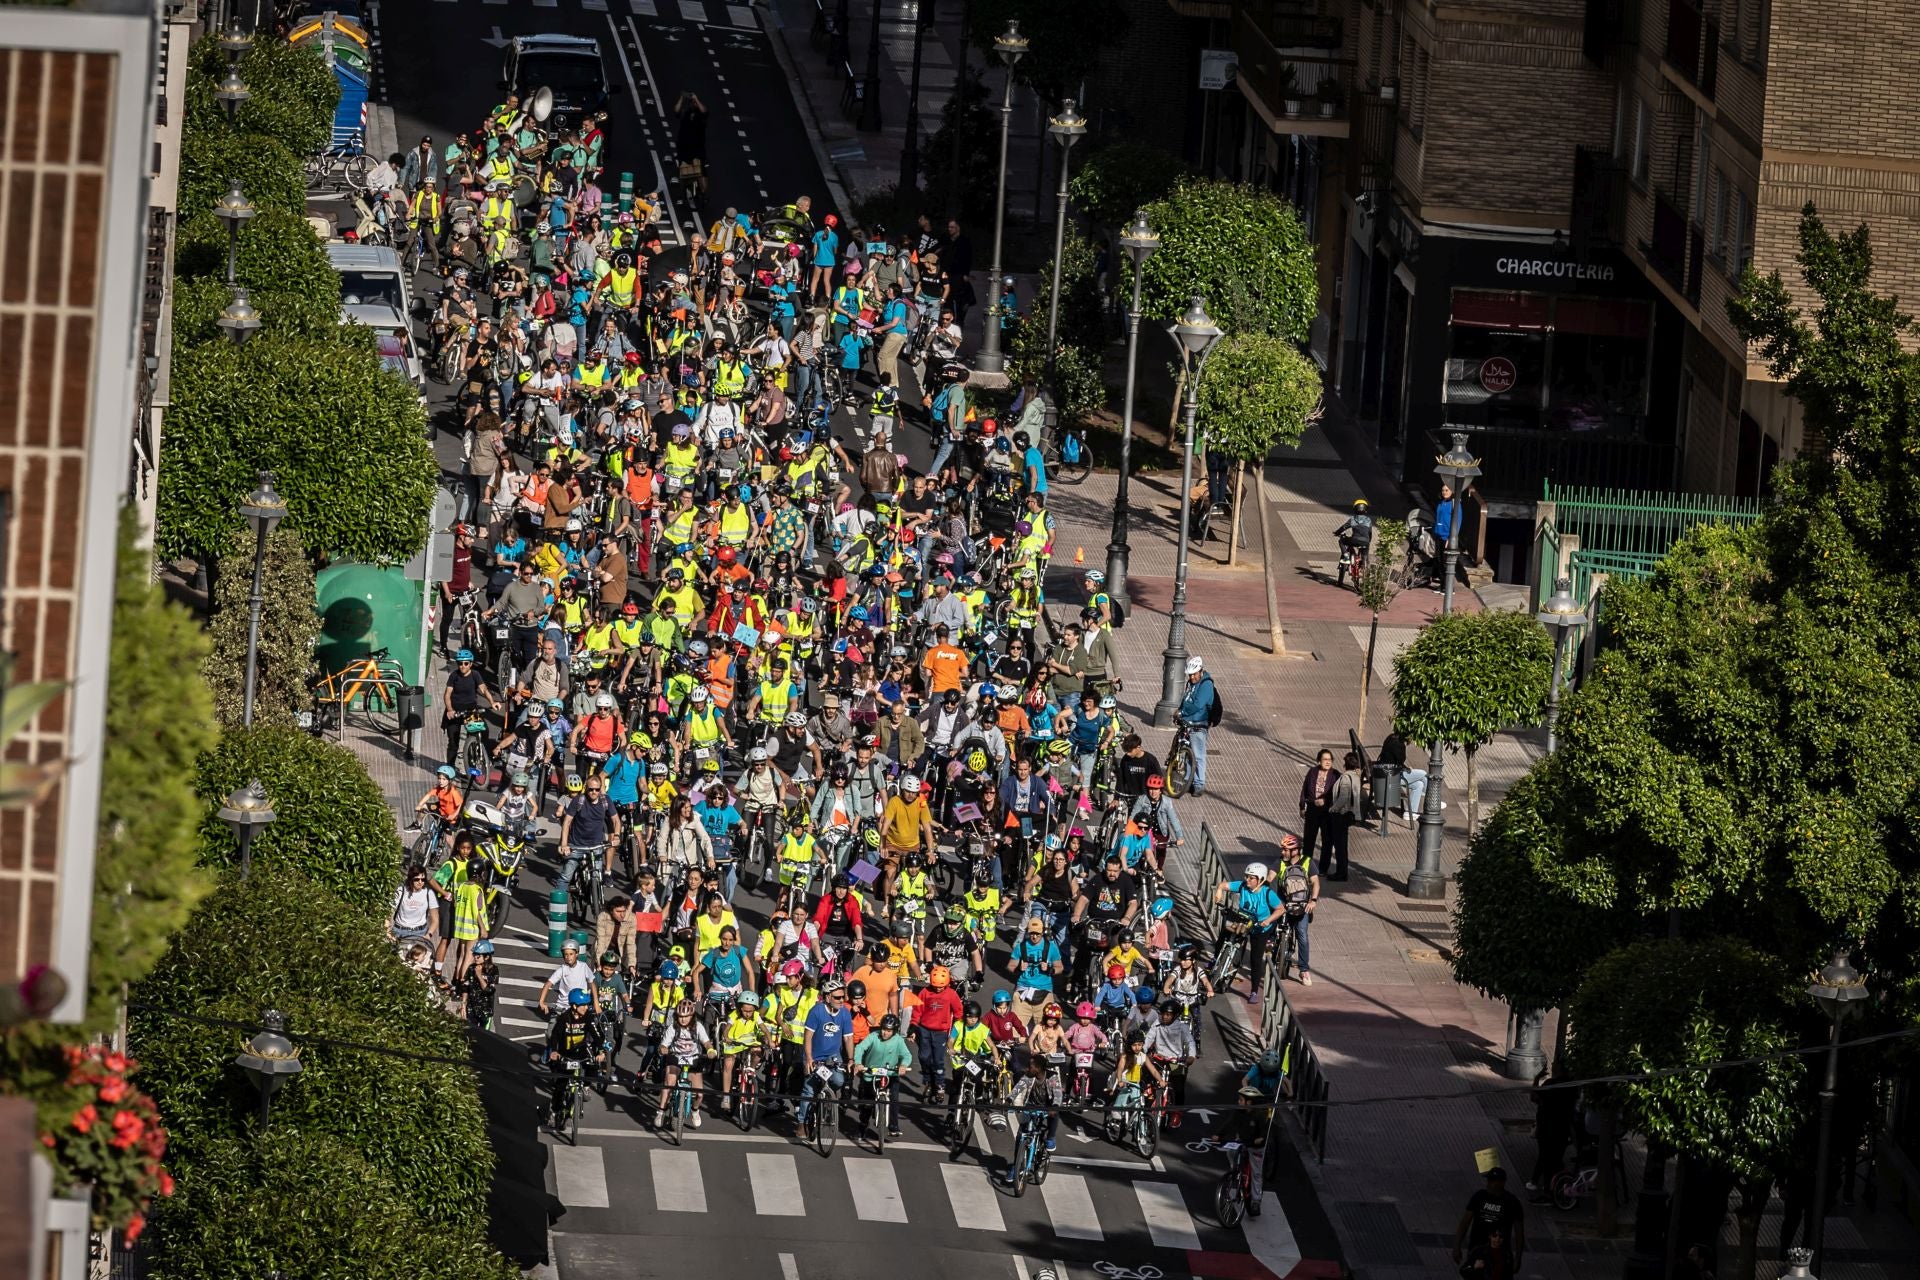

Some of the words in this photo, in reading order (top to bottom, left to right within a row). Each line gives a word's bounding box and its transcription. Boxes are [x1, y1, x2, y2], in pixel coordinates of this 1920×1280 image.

[1496, 257, 1615, 281] CHARCUTERIA
[1486, 363, 1511, 377] حلال
[1485, 377, 1510, 386] HALAL
